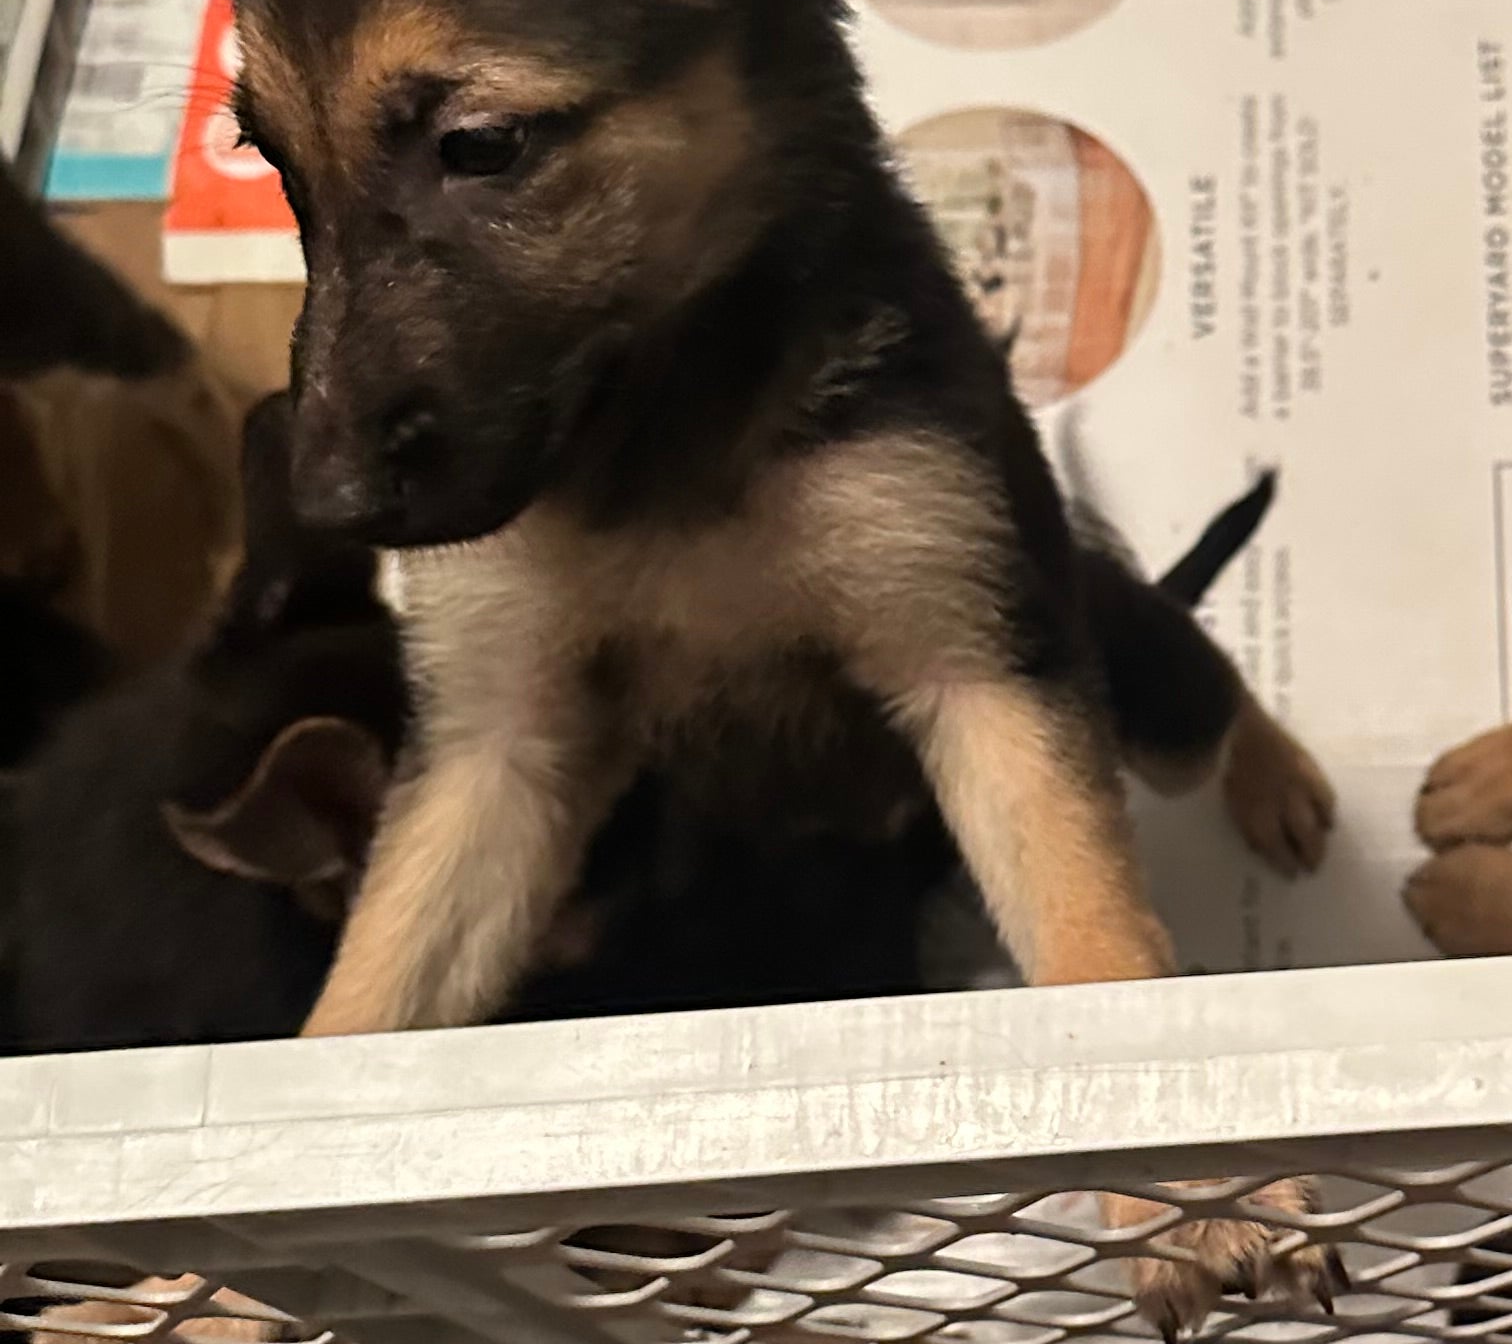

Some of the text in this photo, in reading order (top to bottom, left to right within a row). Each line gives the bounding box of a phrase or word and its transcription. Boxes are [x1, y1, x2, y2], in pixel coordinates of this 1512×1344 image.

[1477, 38, 1505, 102] LIST
[1480, 112, 1509, 216] MODEL
[1189, 175, 1216, 339] VERSATILE
